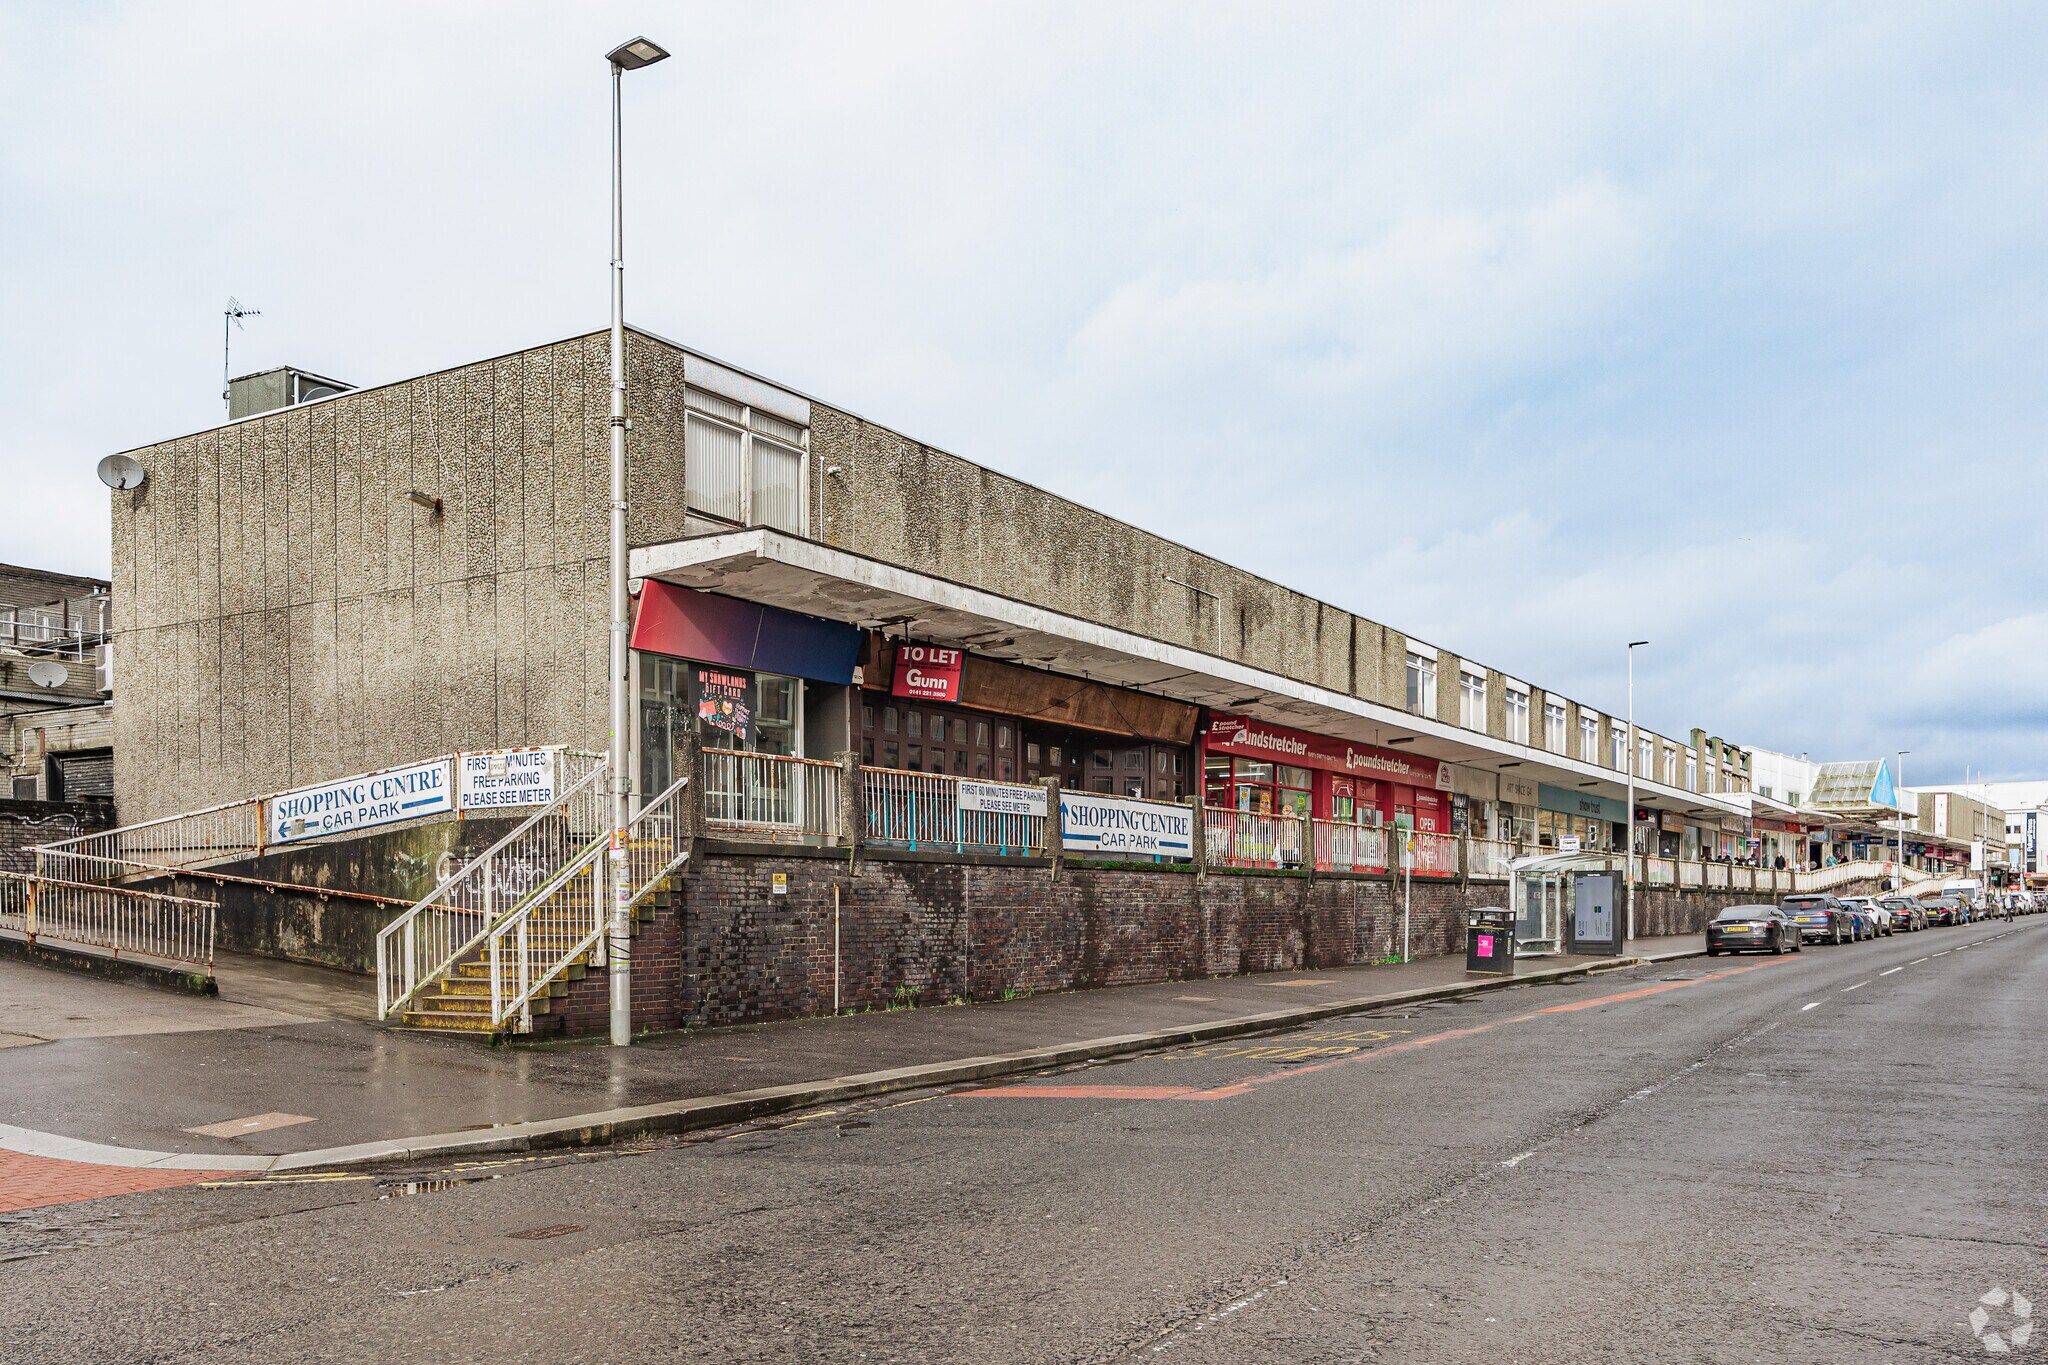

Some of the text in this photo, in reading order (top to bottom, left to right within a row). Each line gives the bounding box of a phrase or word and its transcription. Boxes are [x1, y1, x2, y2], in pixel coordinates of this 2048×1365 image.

[903, 647, 958, 664] TO LET
[699, 670, 747, 689] MY SHAWLANDS
[906, 668, 947, 689] Gunn
[705, 682, 741, 697] GIFT CARD
[473, 771, 540, 788] FREE PARKING
[278, 768, 443, 820] SHOPPING CENTRE
[463, 788, 551, 806] PLEASE SEE METER
[961, 784, 1046, 802] FIRST 60 MINUTES FREE PARKING
[323, 801, 400, 828] CAR PARK
[980, 799, 1031, 813] PLEASE SEE METER
[1070, 804, 1189, 836] SHOPPING CENTRE
[1419, 817, 1436, 831] OPEN
[1101, 832, 1158, 850] CAR PARK
[1164, 1046, 1360, 1060] STOP
